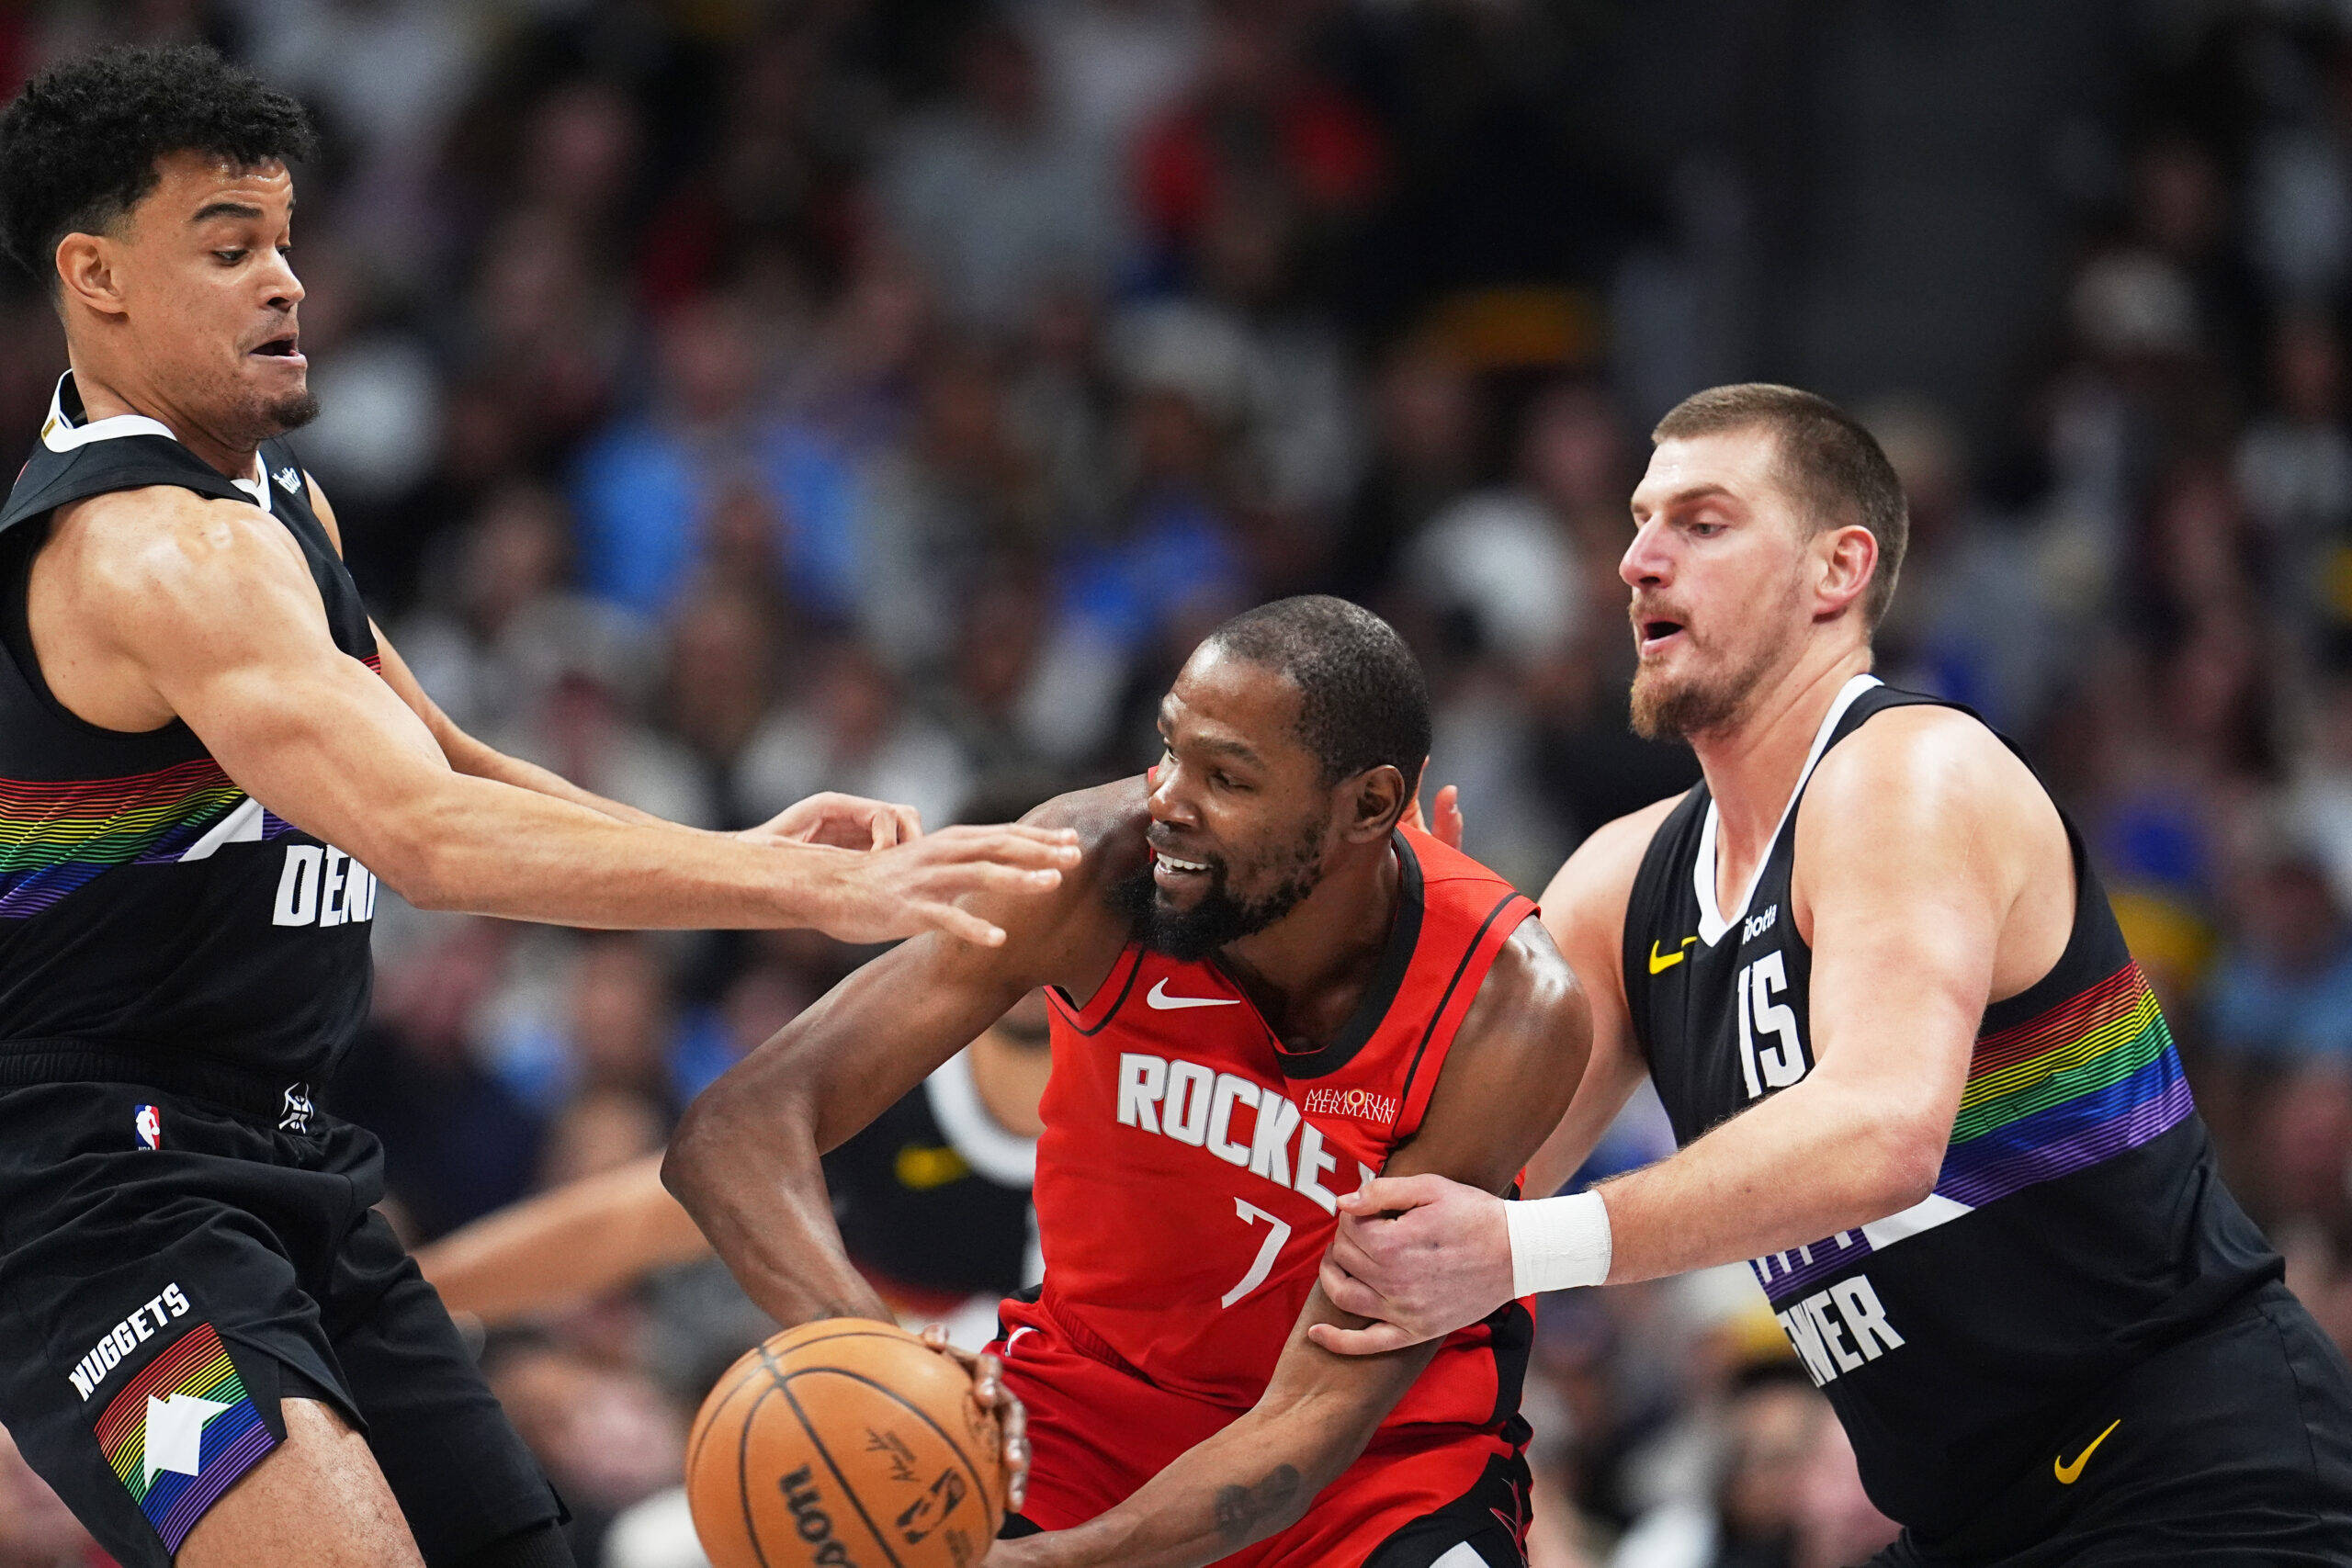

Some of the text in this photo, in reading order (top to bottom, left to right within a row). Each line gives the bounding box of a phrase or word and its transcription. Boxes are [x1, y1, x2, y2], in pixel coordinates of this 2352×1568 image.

[272, 843, 378, 928] DEN
[1737, 949, 1806, 1100] 15
[1116, 1052, 1376, 1217] ROCKE
[1304, 1098, 1396, 1125] HERMANN
[1305, 1088, 1396, 1114] MEMORIAL
[1221, 1196, 1292, 1311] 7
[68, 1281, 190, 1402] NUGGETS
